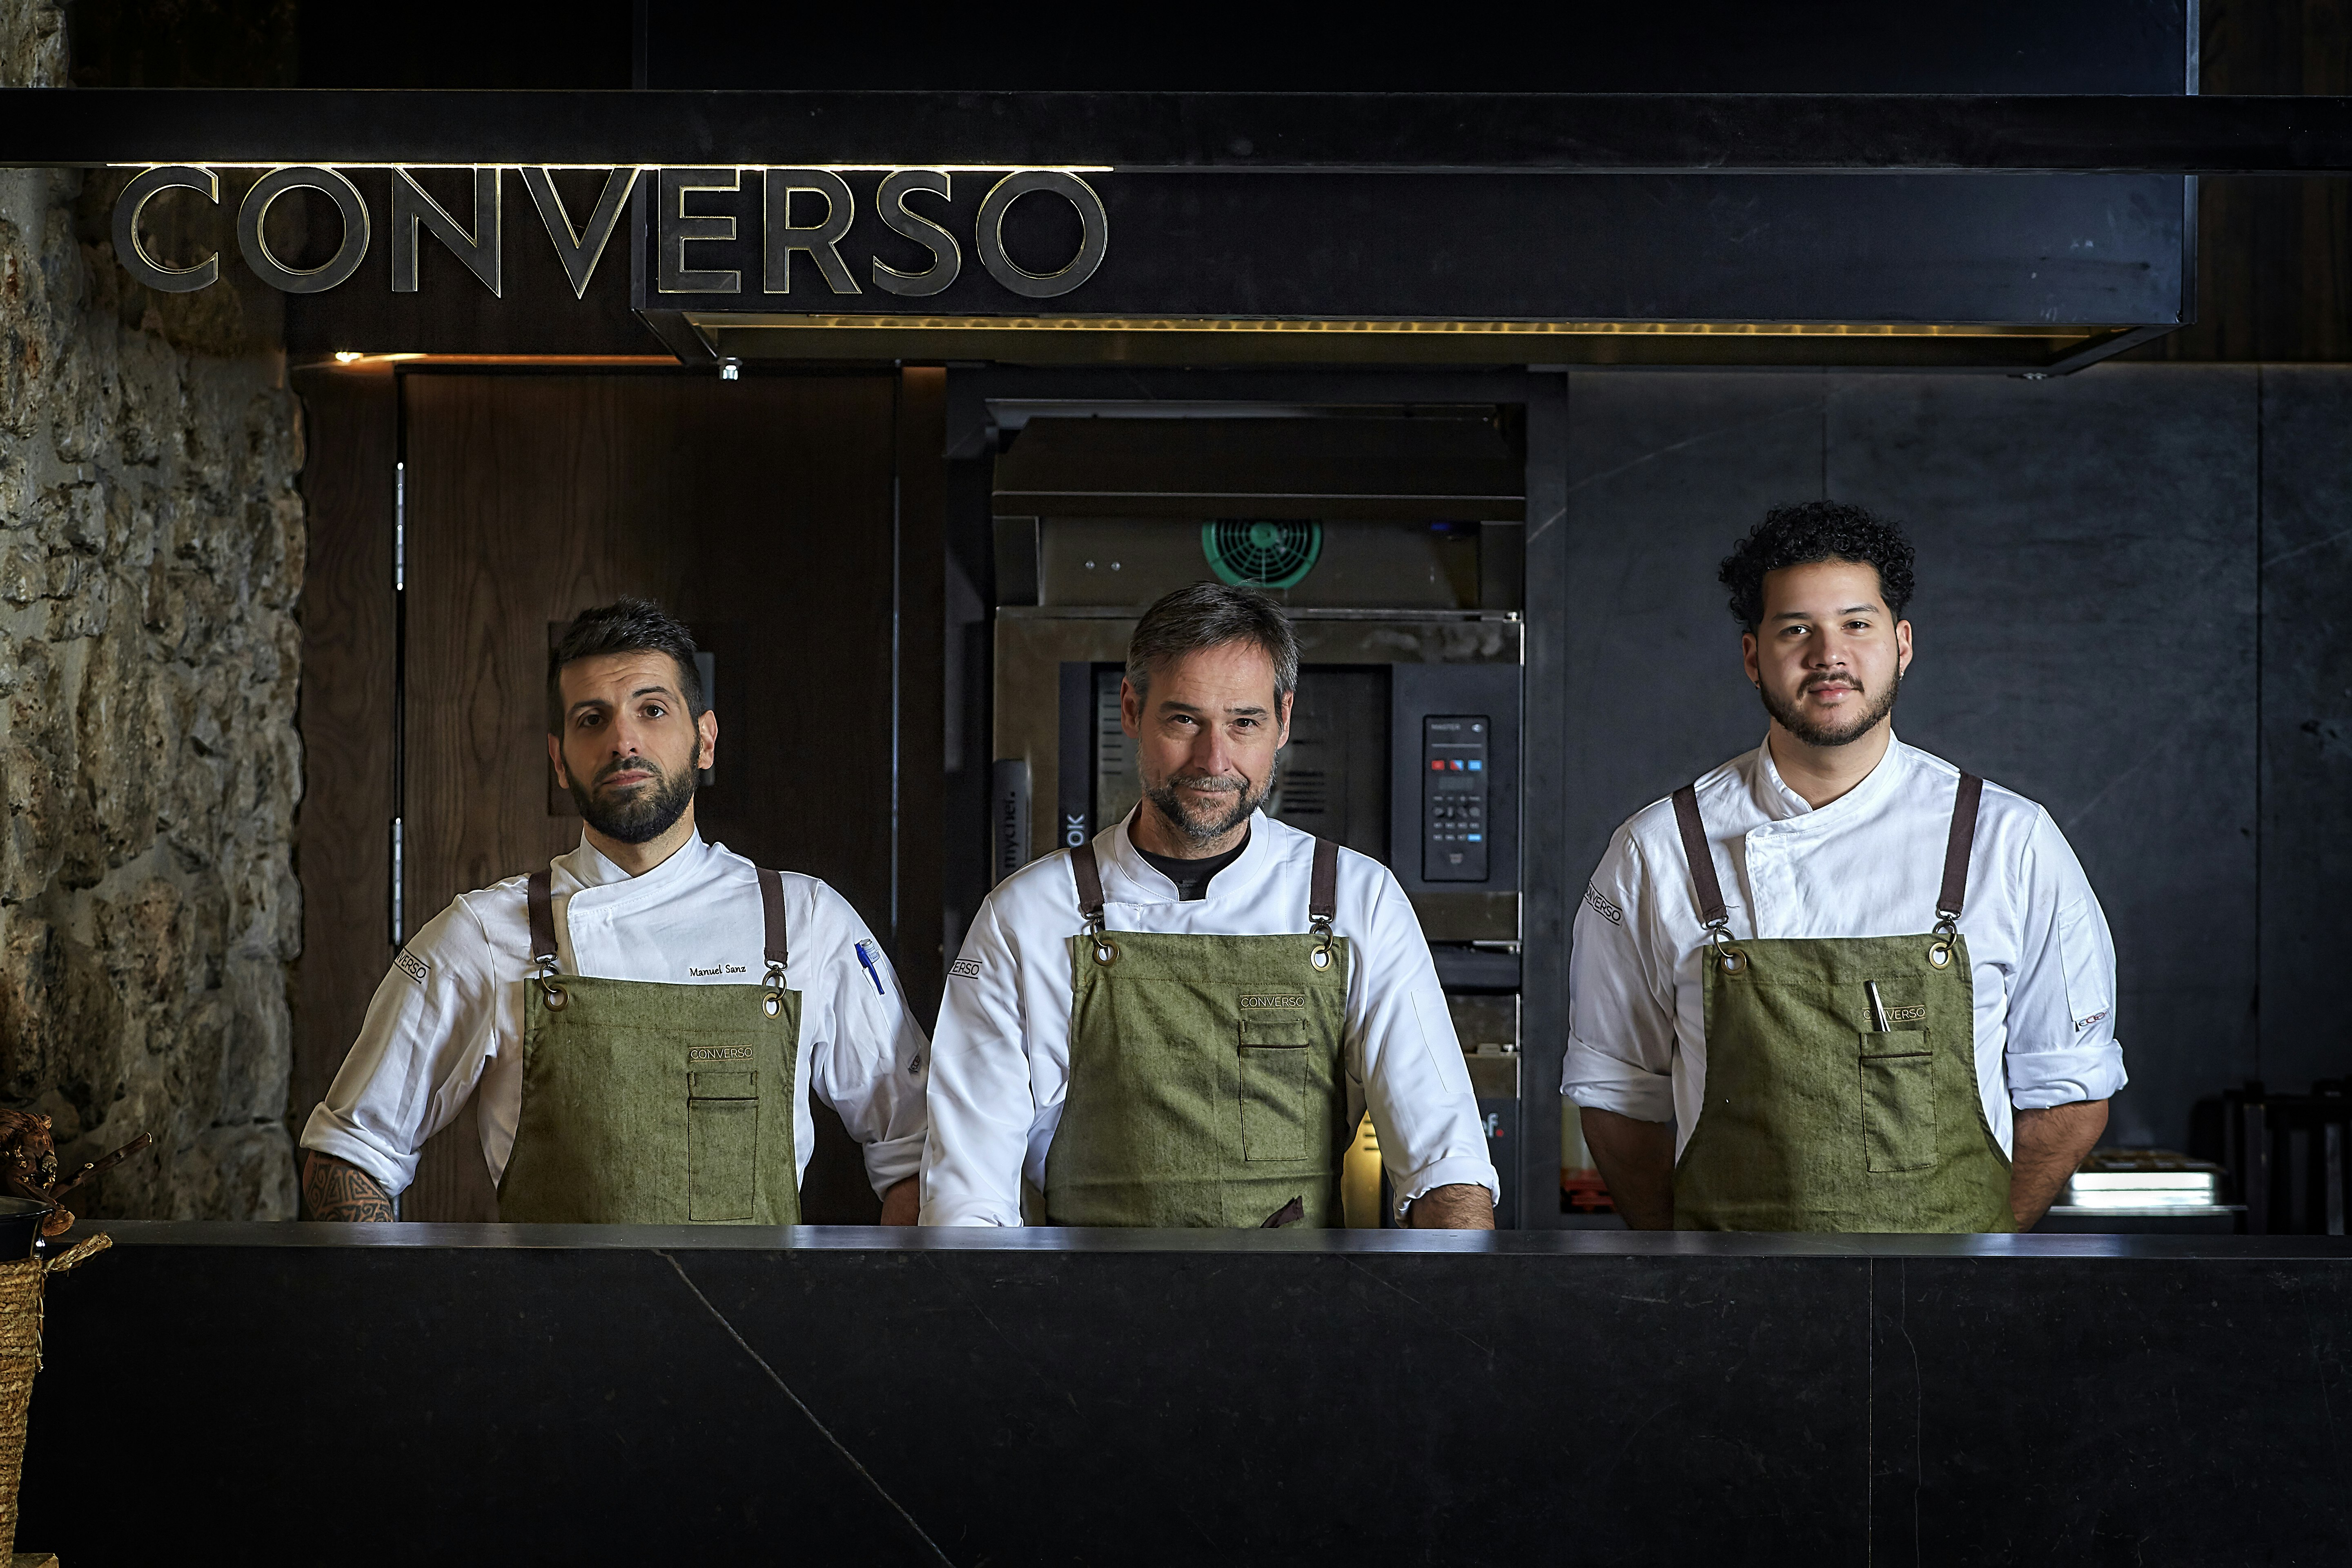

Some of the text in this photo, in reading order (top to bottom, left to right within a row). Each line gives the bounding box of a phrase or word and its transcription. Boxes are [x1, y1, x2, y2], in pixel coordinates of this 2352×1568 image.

[111, 165, 1108, 299] CONVERSO
[690, 964, 746, 976] Manuel Sanz
[1241, 997, 1304, 1007] CONVERSO
[690, 1047, 753, 1059] CONVERSO
